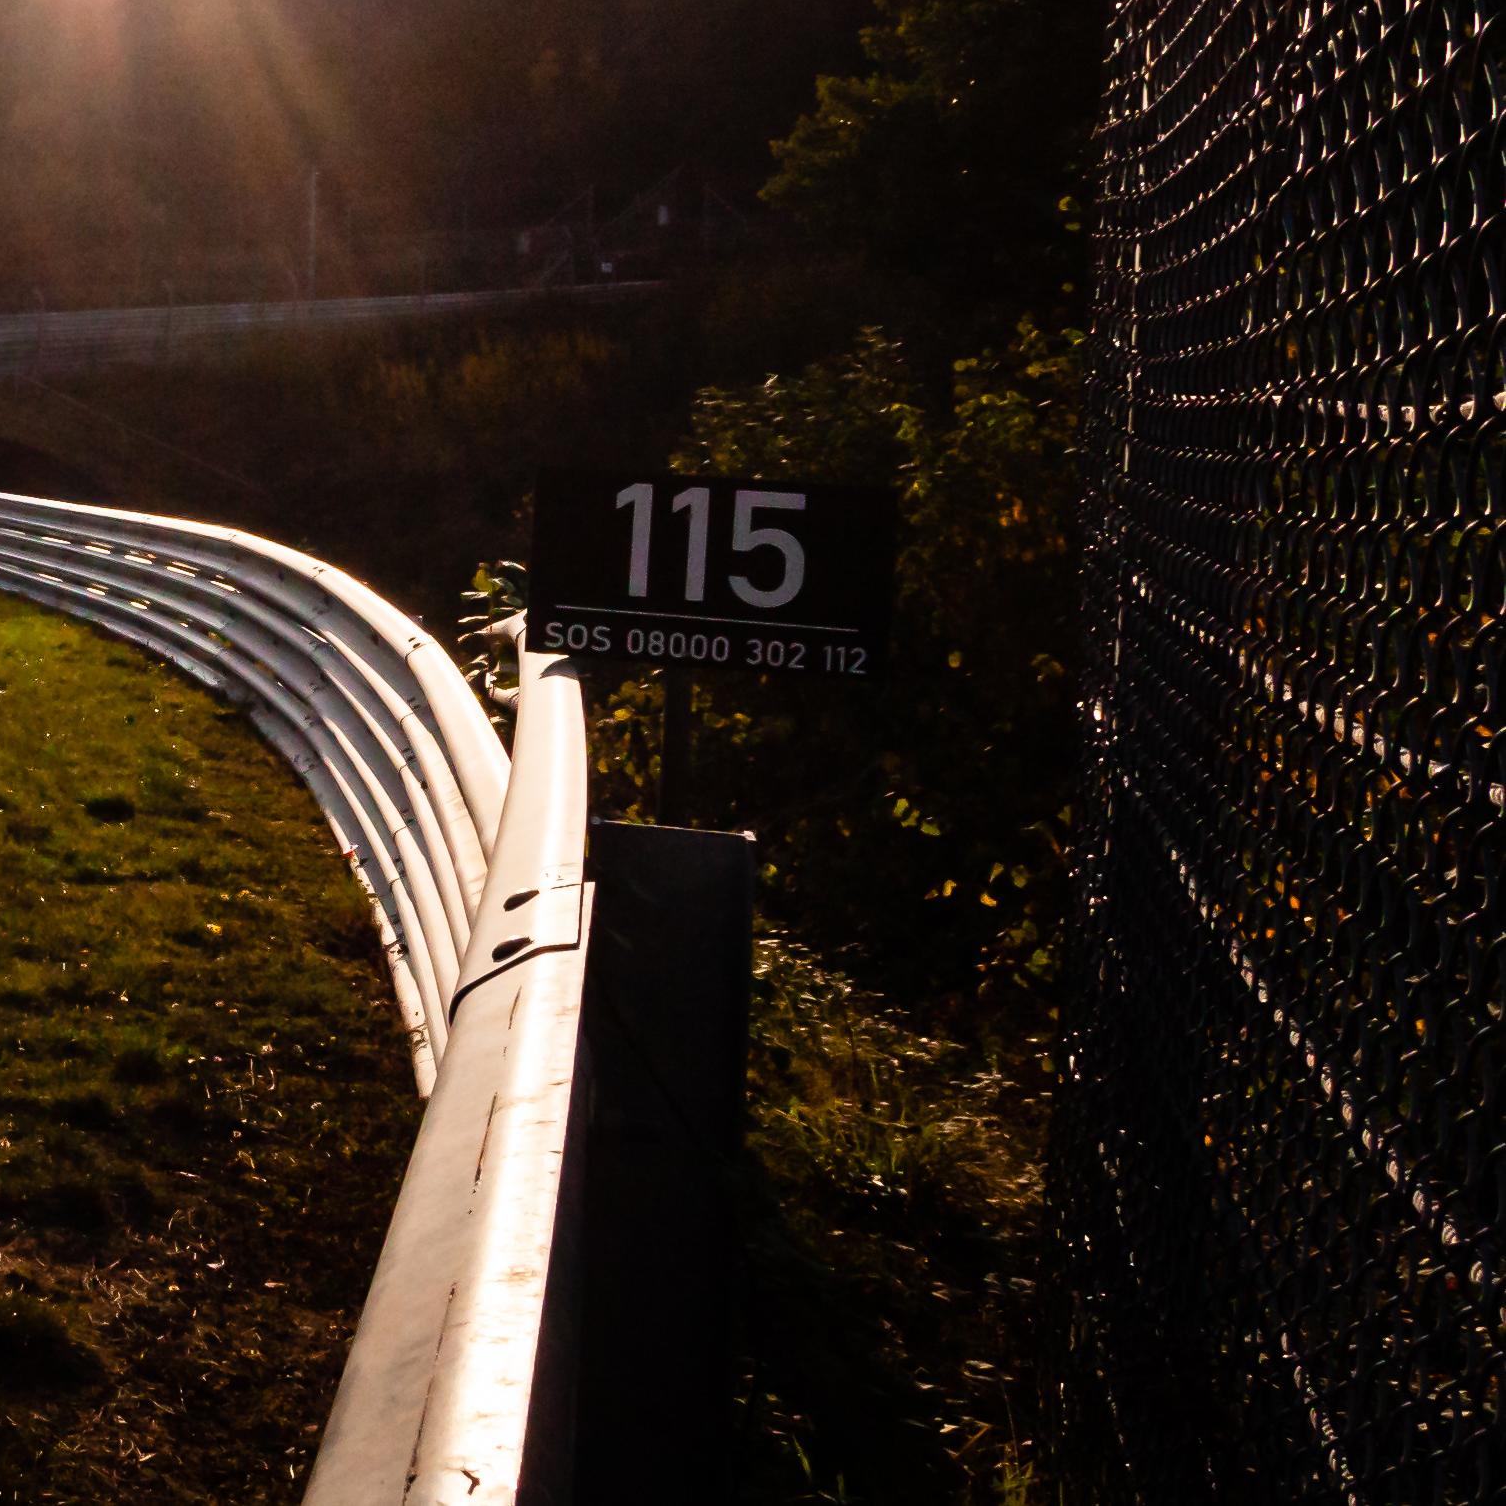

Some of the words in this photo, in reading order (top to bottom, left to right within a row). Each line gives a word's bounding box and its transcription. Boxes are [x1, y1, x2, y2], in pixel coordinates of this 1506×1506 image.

[615, 482, 807, 608] 115
[543, 621, 612, 652] SOS
[626, 628, 730, 662] 08000
[745, 638, 806, 669] 302
[824, 645, 868, 675] 112
